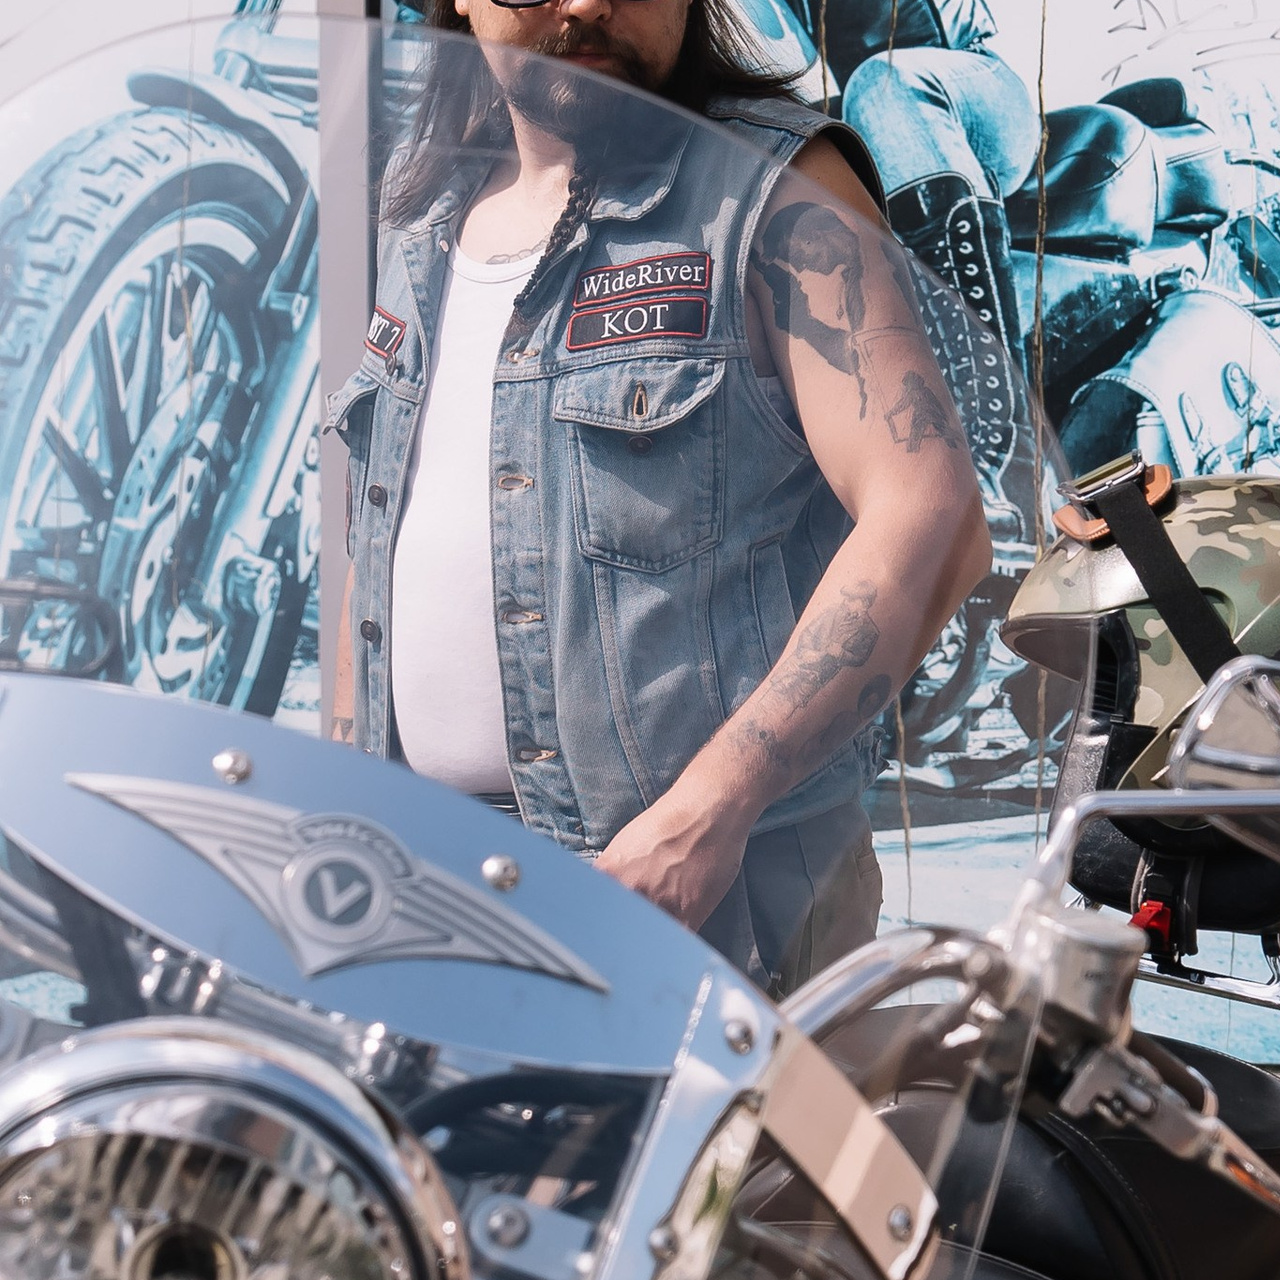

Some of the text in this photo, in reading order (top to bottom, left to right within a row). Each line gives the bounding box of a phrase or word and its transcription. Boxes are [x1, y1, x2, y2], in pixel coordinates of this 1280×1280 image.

[582, 261, 704, 299] WideRiver
[601, 305, 669, 338] KOT
[384, 326, 401, 351] 7
